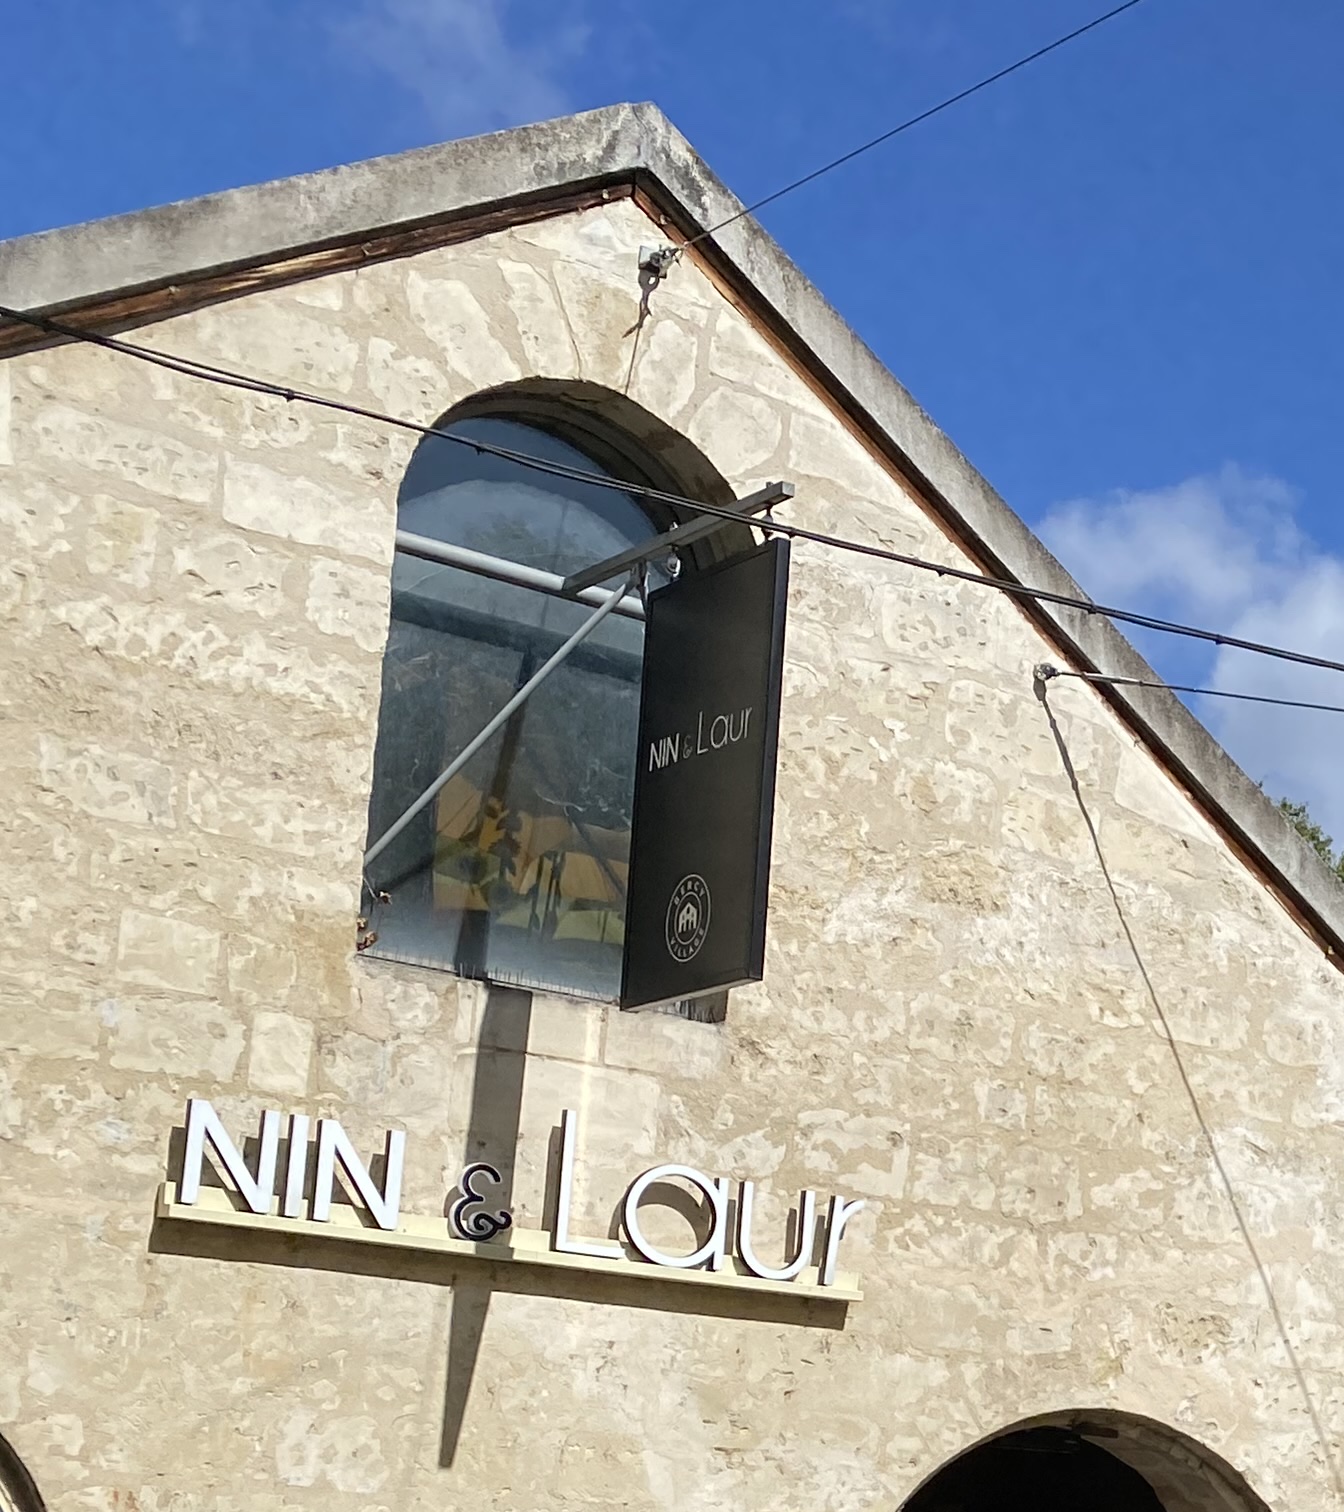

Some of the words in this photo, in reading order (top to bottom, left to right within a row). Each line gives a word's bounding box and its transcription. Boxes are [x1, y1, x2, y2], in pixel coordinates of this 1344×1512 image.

[649, 732, 680, 772] NIN
[682, 734, 693, 759] &
[697, 706, 752, 755] Laur
[178, 1097, 406, 1231] NIN
[449, 1162, 512, 1242] &
[550, 1108, 865, 1286] Laur
